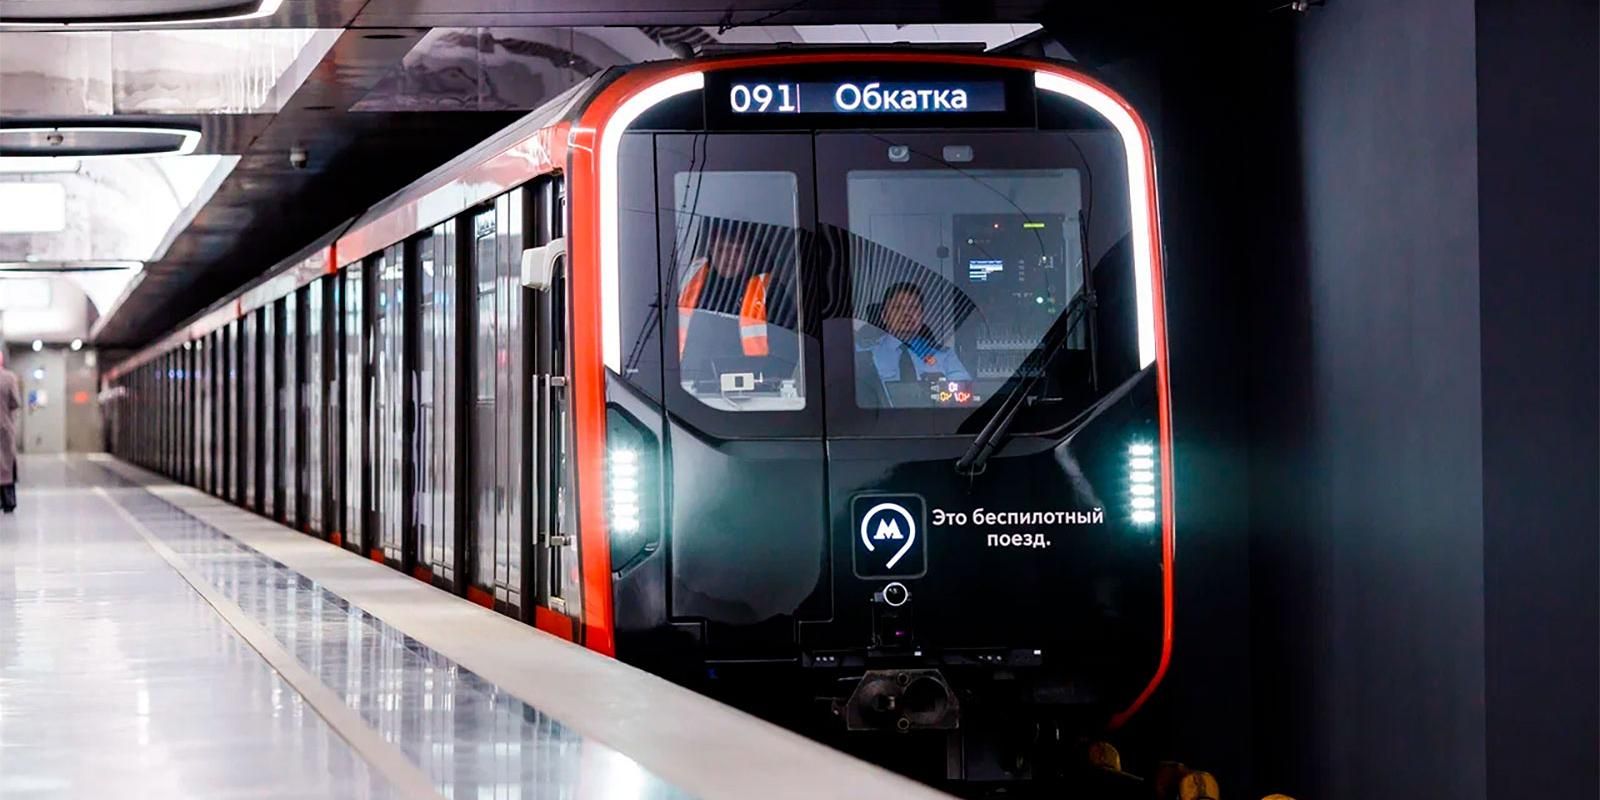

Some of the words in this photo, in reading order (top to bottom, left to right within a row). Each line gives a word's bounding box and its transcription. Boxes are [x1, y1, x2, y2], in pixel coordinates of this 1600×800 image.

[730, 84, 795, 113] 091
[835, 82, 968, 110] Обкатка
[932, 508, 968, 525] Это
[972, 506, 1104, 525] беспилотный
[986, 533, 1052, 549] поезд.
